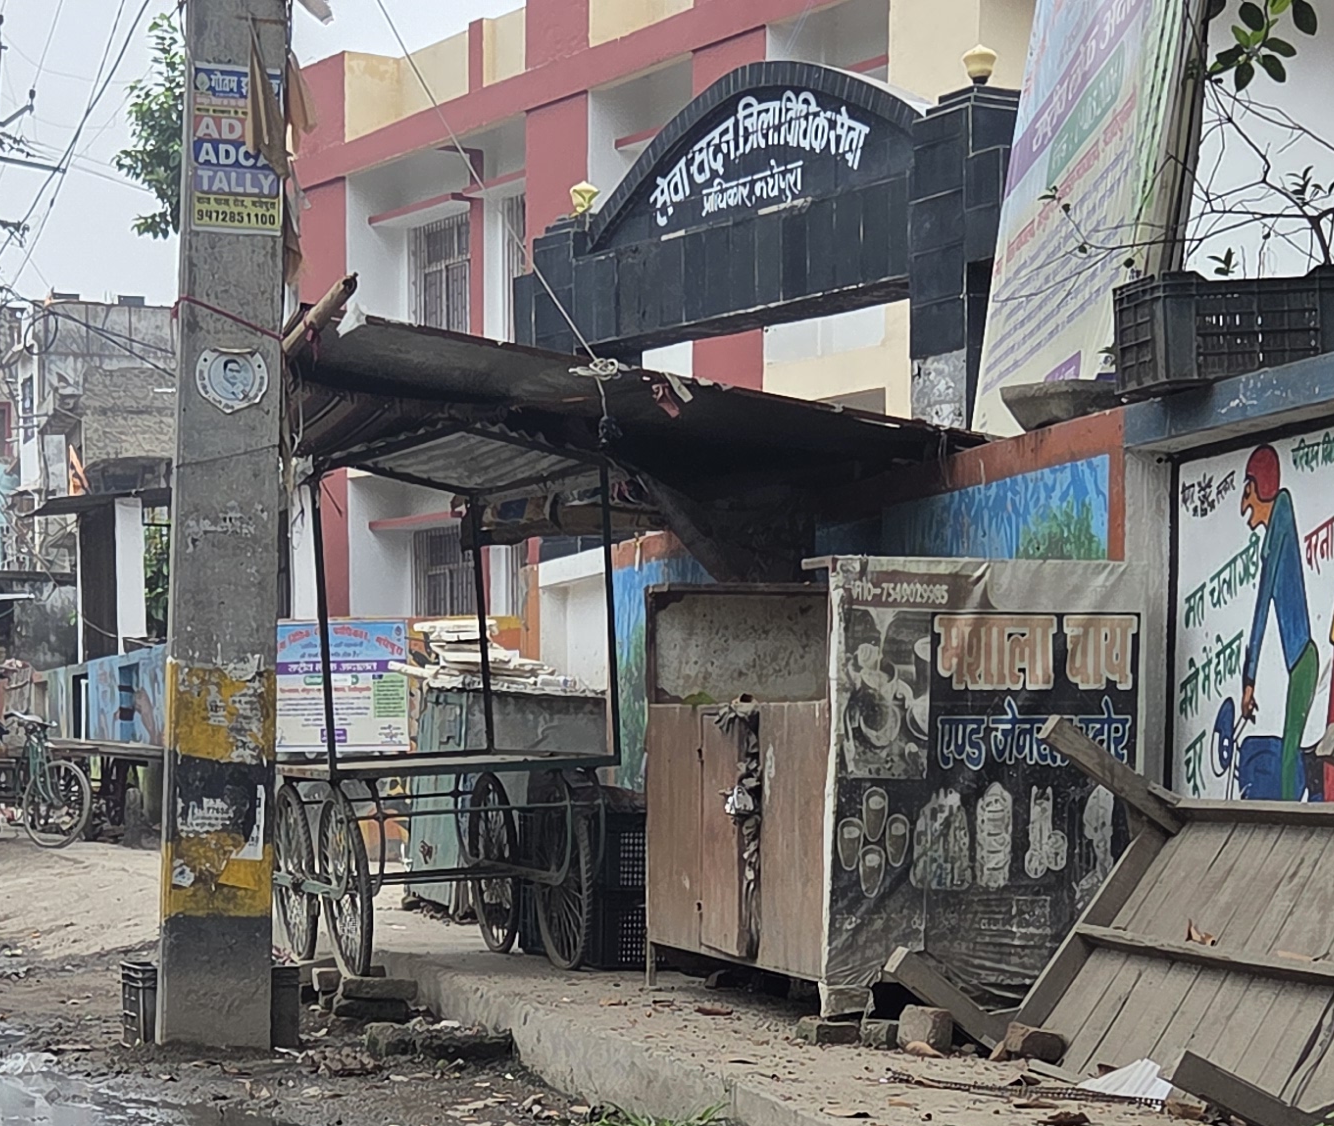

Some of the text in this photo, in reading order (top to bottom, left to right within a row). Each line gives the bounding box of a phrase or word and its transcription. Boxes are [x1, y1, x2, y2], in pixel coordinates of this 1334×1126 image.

[197, 169, 275, 195] TALLY
[196, 208, 276, 226] 9472851100
[1184, 581, 1207, 630] मत
[1063, 614, 1138, 691] चाय
[937, 714, 988, 771] एण्ड
[988, 695, 1075, 766] जेनर
[1184, 729, 1207, 799] चूर
